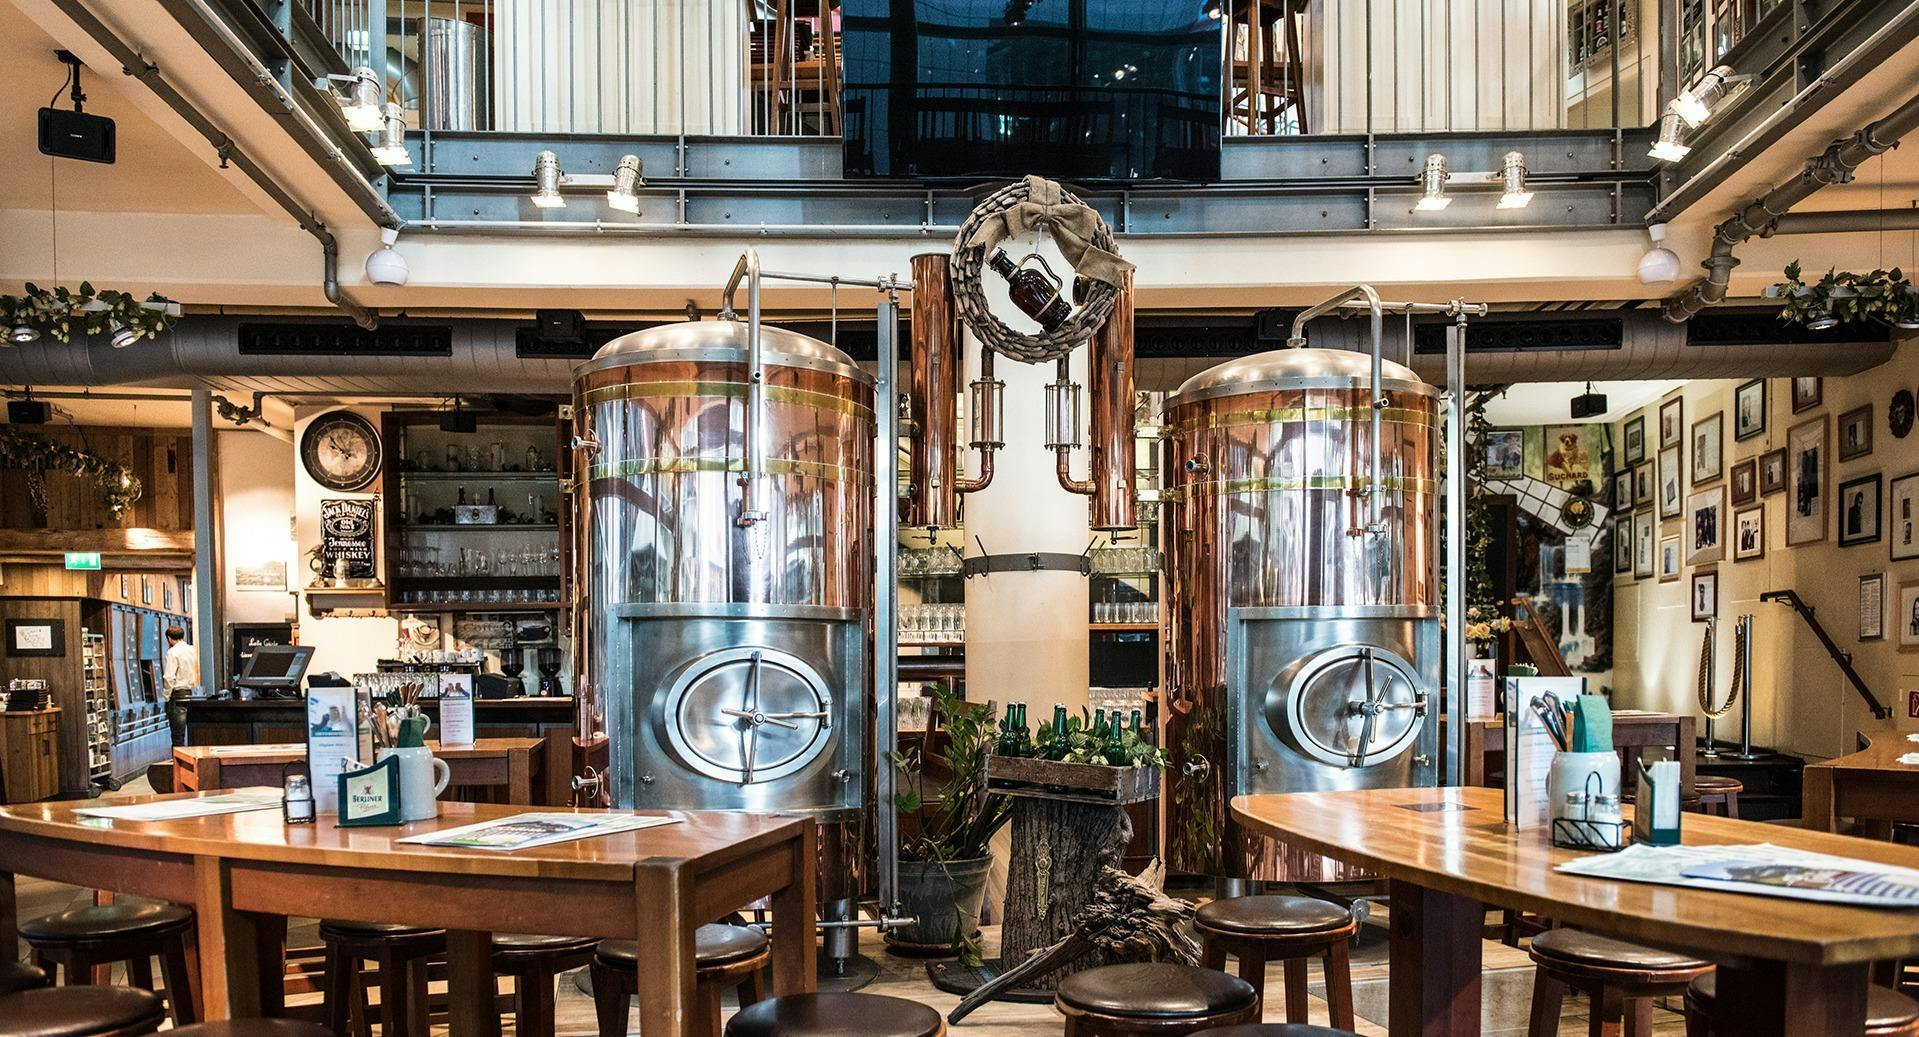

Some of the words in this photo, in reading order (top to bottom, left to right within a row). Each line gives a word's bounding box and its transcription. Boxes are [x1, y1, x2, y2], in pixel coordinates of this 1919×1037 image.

[1548, 472, 1588, 481] SUCHARD
[323, 504, 341, 519] JACK
[341, 502, 369, 520] DANIEL'S
[328, 537, 366, 547] Tennessee
[325, 551, 370, 559] WHISKEY
